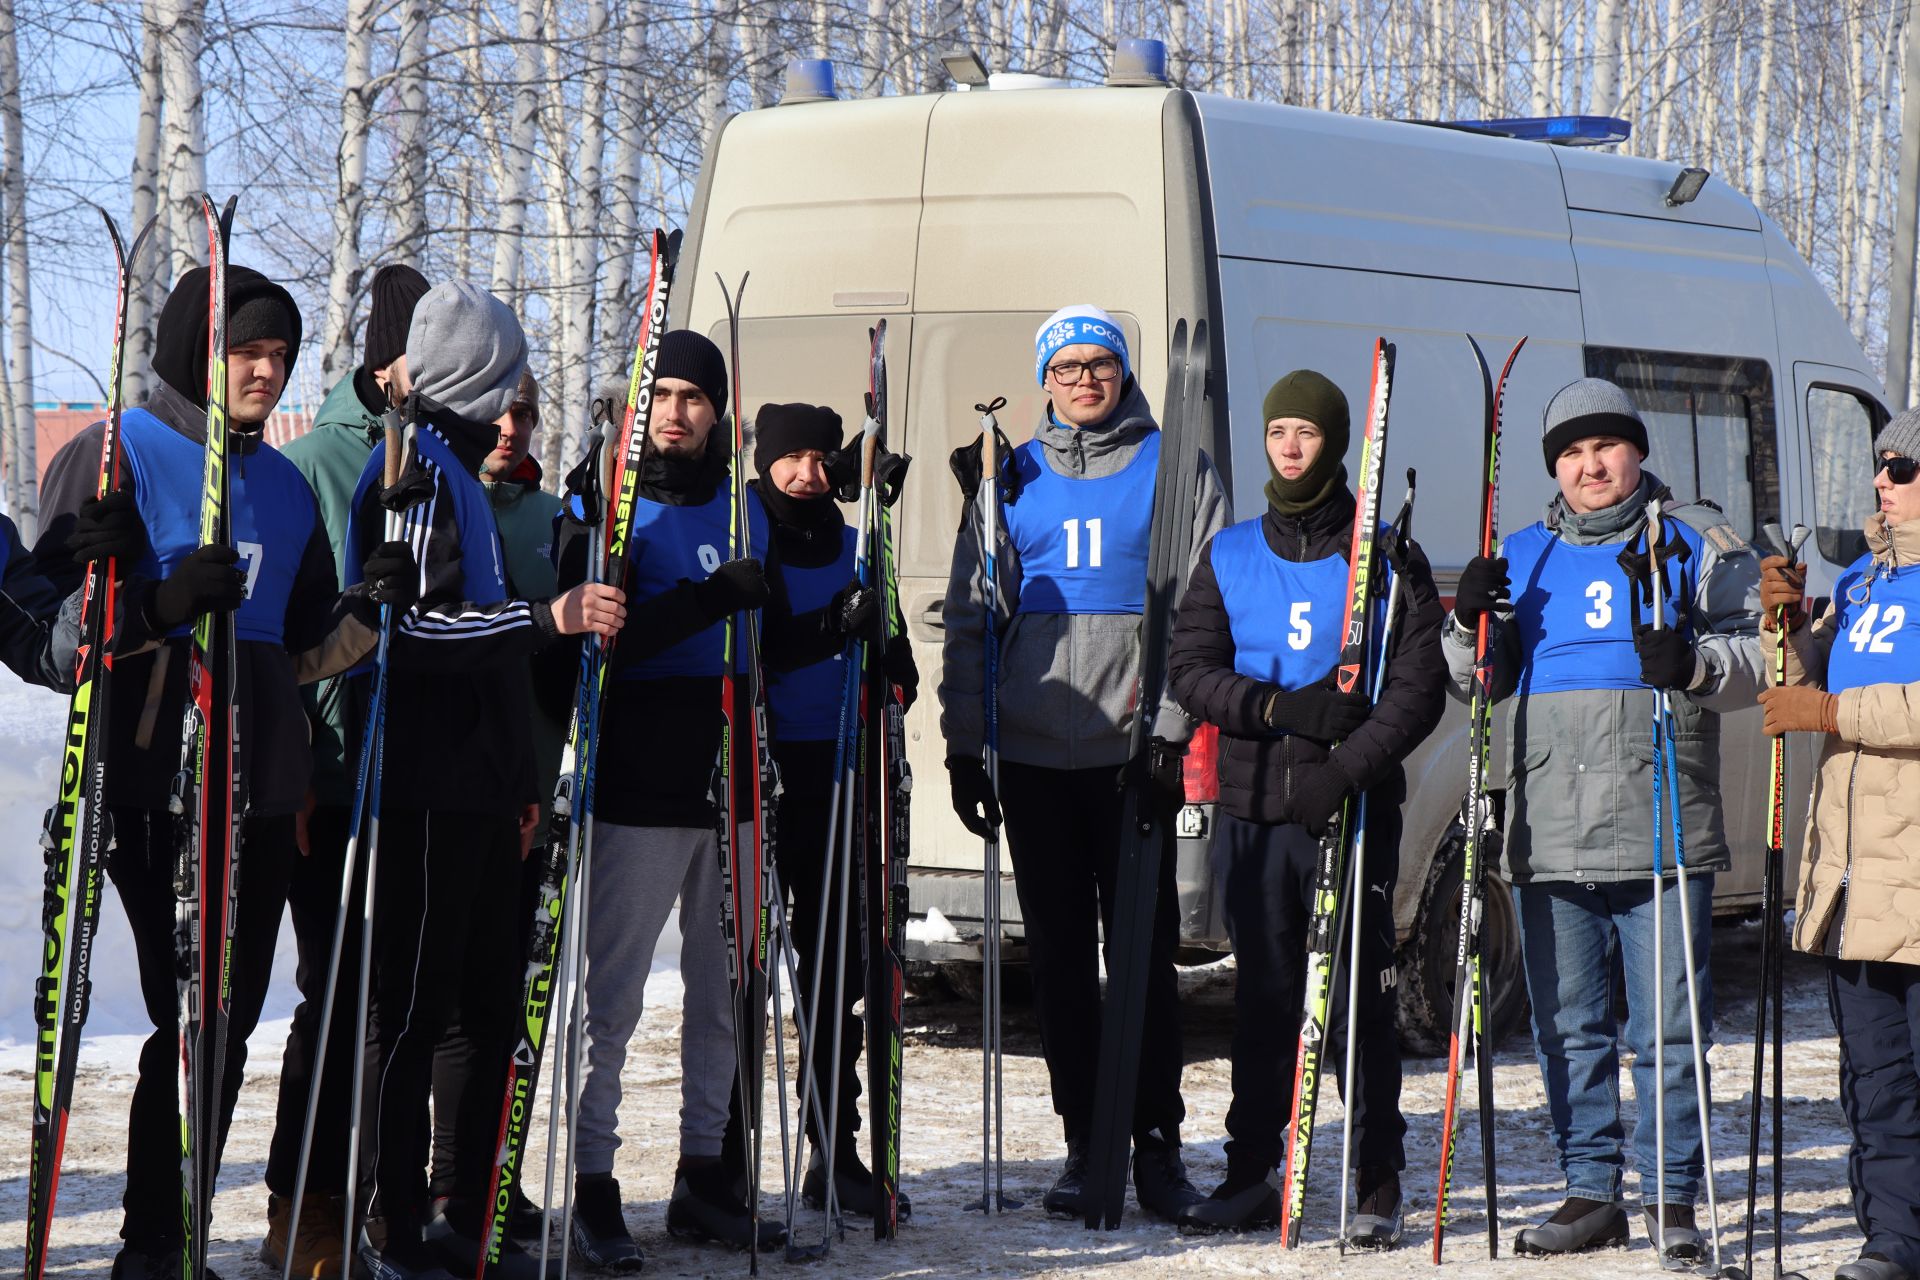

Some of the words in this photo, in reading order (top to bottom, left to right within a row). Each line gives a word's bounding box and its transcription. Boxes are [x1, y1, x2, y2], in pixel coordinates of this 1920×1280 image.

[610, 469, 637, 557] SABLE
[237, 541, 263, 600] 7
[1063, 518, 1101, 568] 11
[1353, 540, 1373, 613] SABLE
[1287, 602, 1311, 650] 5
[1585, 581, 1613, 629] 3
[1848, 603, 1906, 653] 42
[195, 724, 206, 784] BRADOS
[722, 725, 730, 776] BRADOS
[759, 908, 768, 960] BRADOS
[222, 939, 232, 999] BRADOS
[887, 1031, 900, 1184] SKATE
